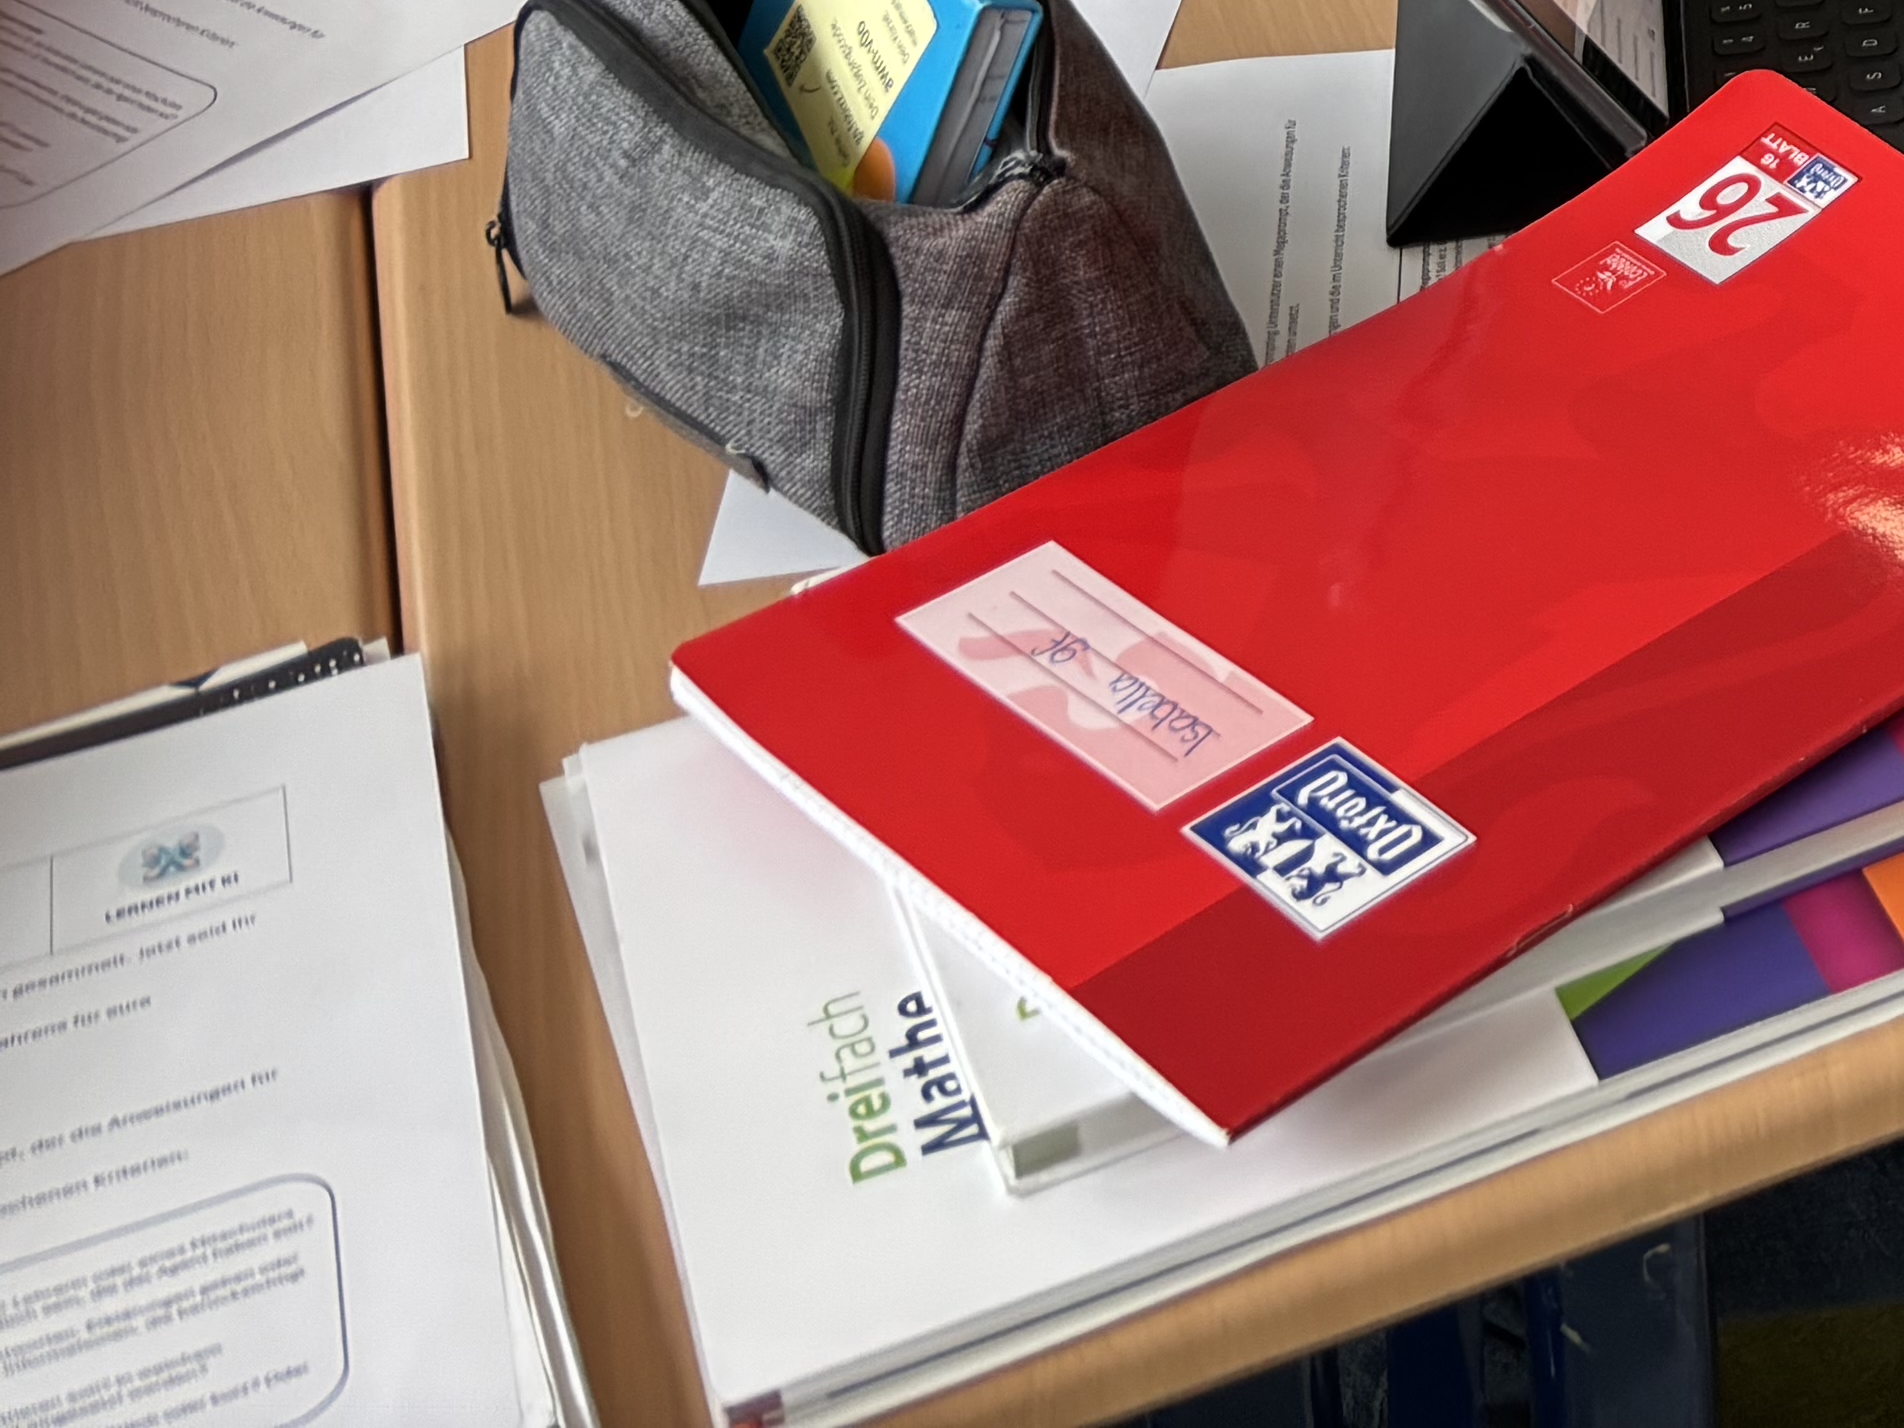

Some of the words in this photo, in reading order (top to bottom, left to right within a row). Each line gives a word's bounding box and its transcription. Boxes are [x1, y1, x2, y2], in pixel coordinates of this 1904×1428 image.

[1760, 153, 1779, 169] 16
[1761, 133, 1809, 166] BLATT
[1665, 172, 1809, 257] 26
[1108, 670, 1222, 756] Isabella
[1297, 769, 1424, 875] Oxford
[807, 991, 907, 1185] Dreifach
[889, 991, 990, 1157] Mathe
